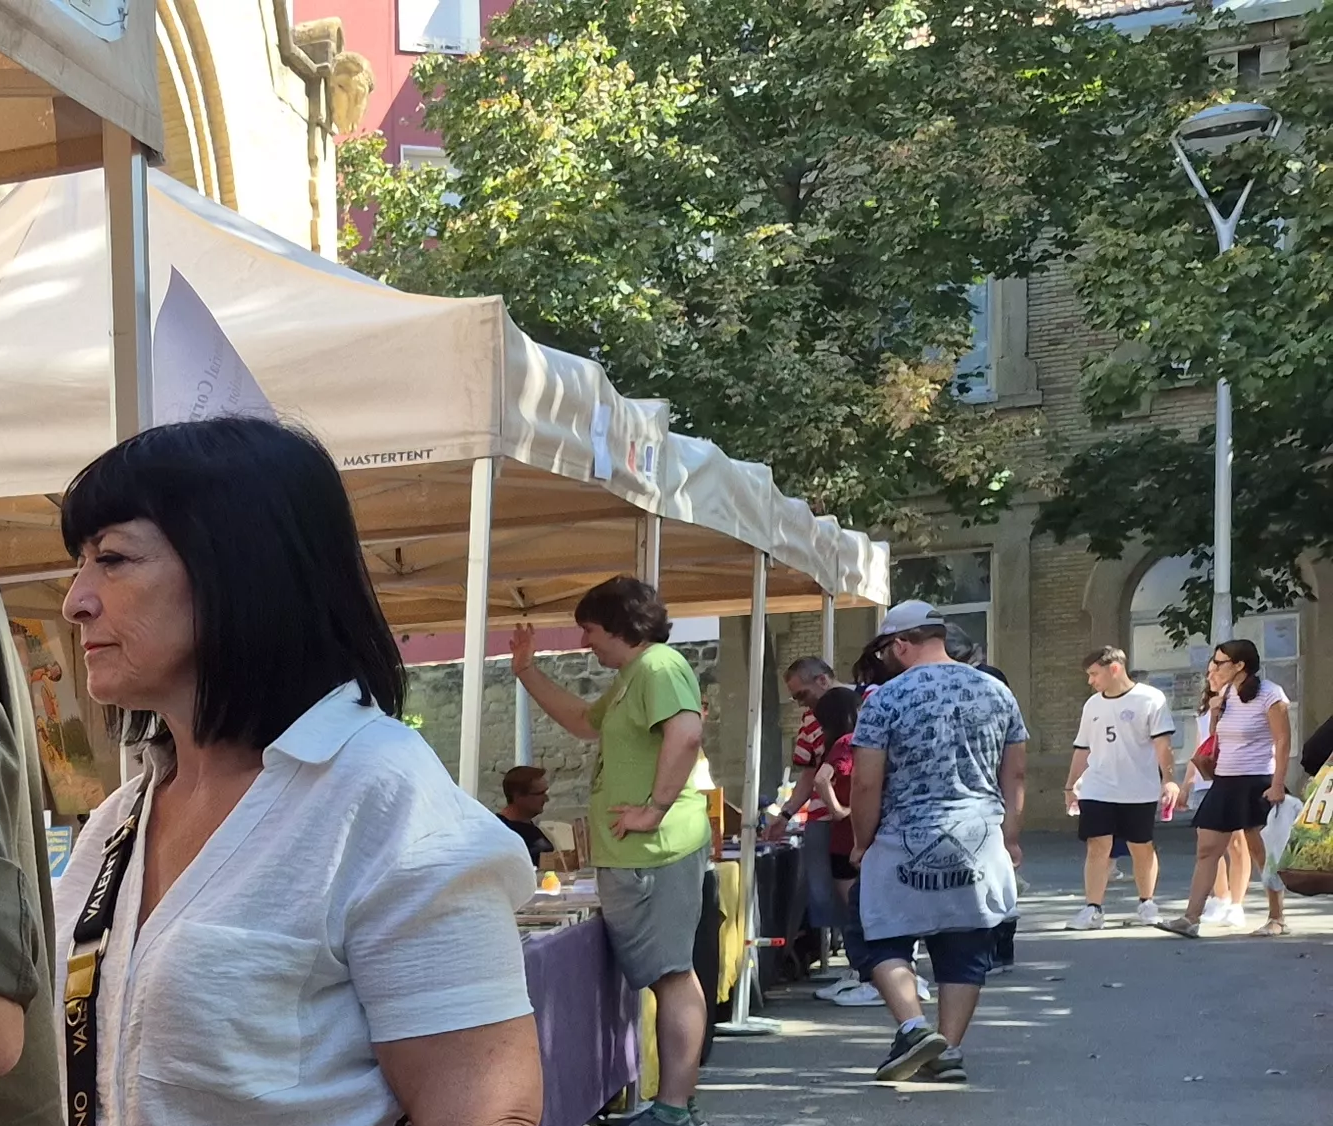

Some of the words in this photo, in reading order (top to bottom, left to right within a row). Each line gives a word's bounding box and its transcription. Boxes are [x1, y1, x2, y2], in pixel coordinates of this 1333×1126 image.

[343, 448, 435, 467] MASTERTENT
[1106, 726, 1117, 743] 5
[83, 851, 119, 923] VALENT
[896, 864, 941, 891] STILL
[942, 868, 985, 890] LIVES
